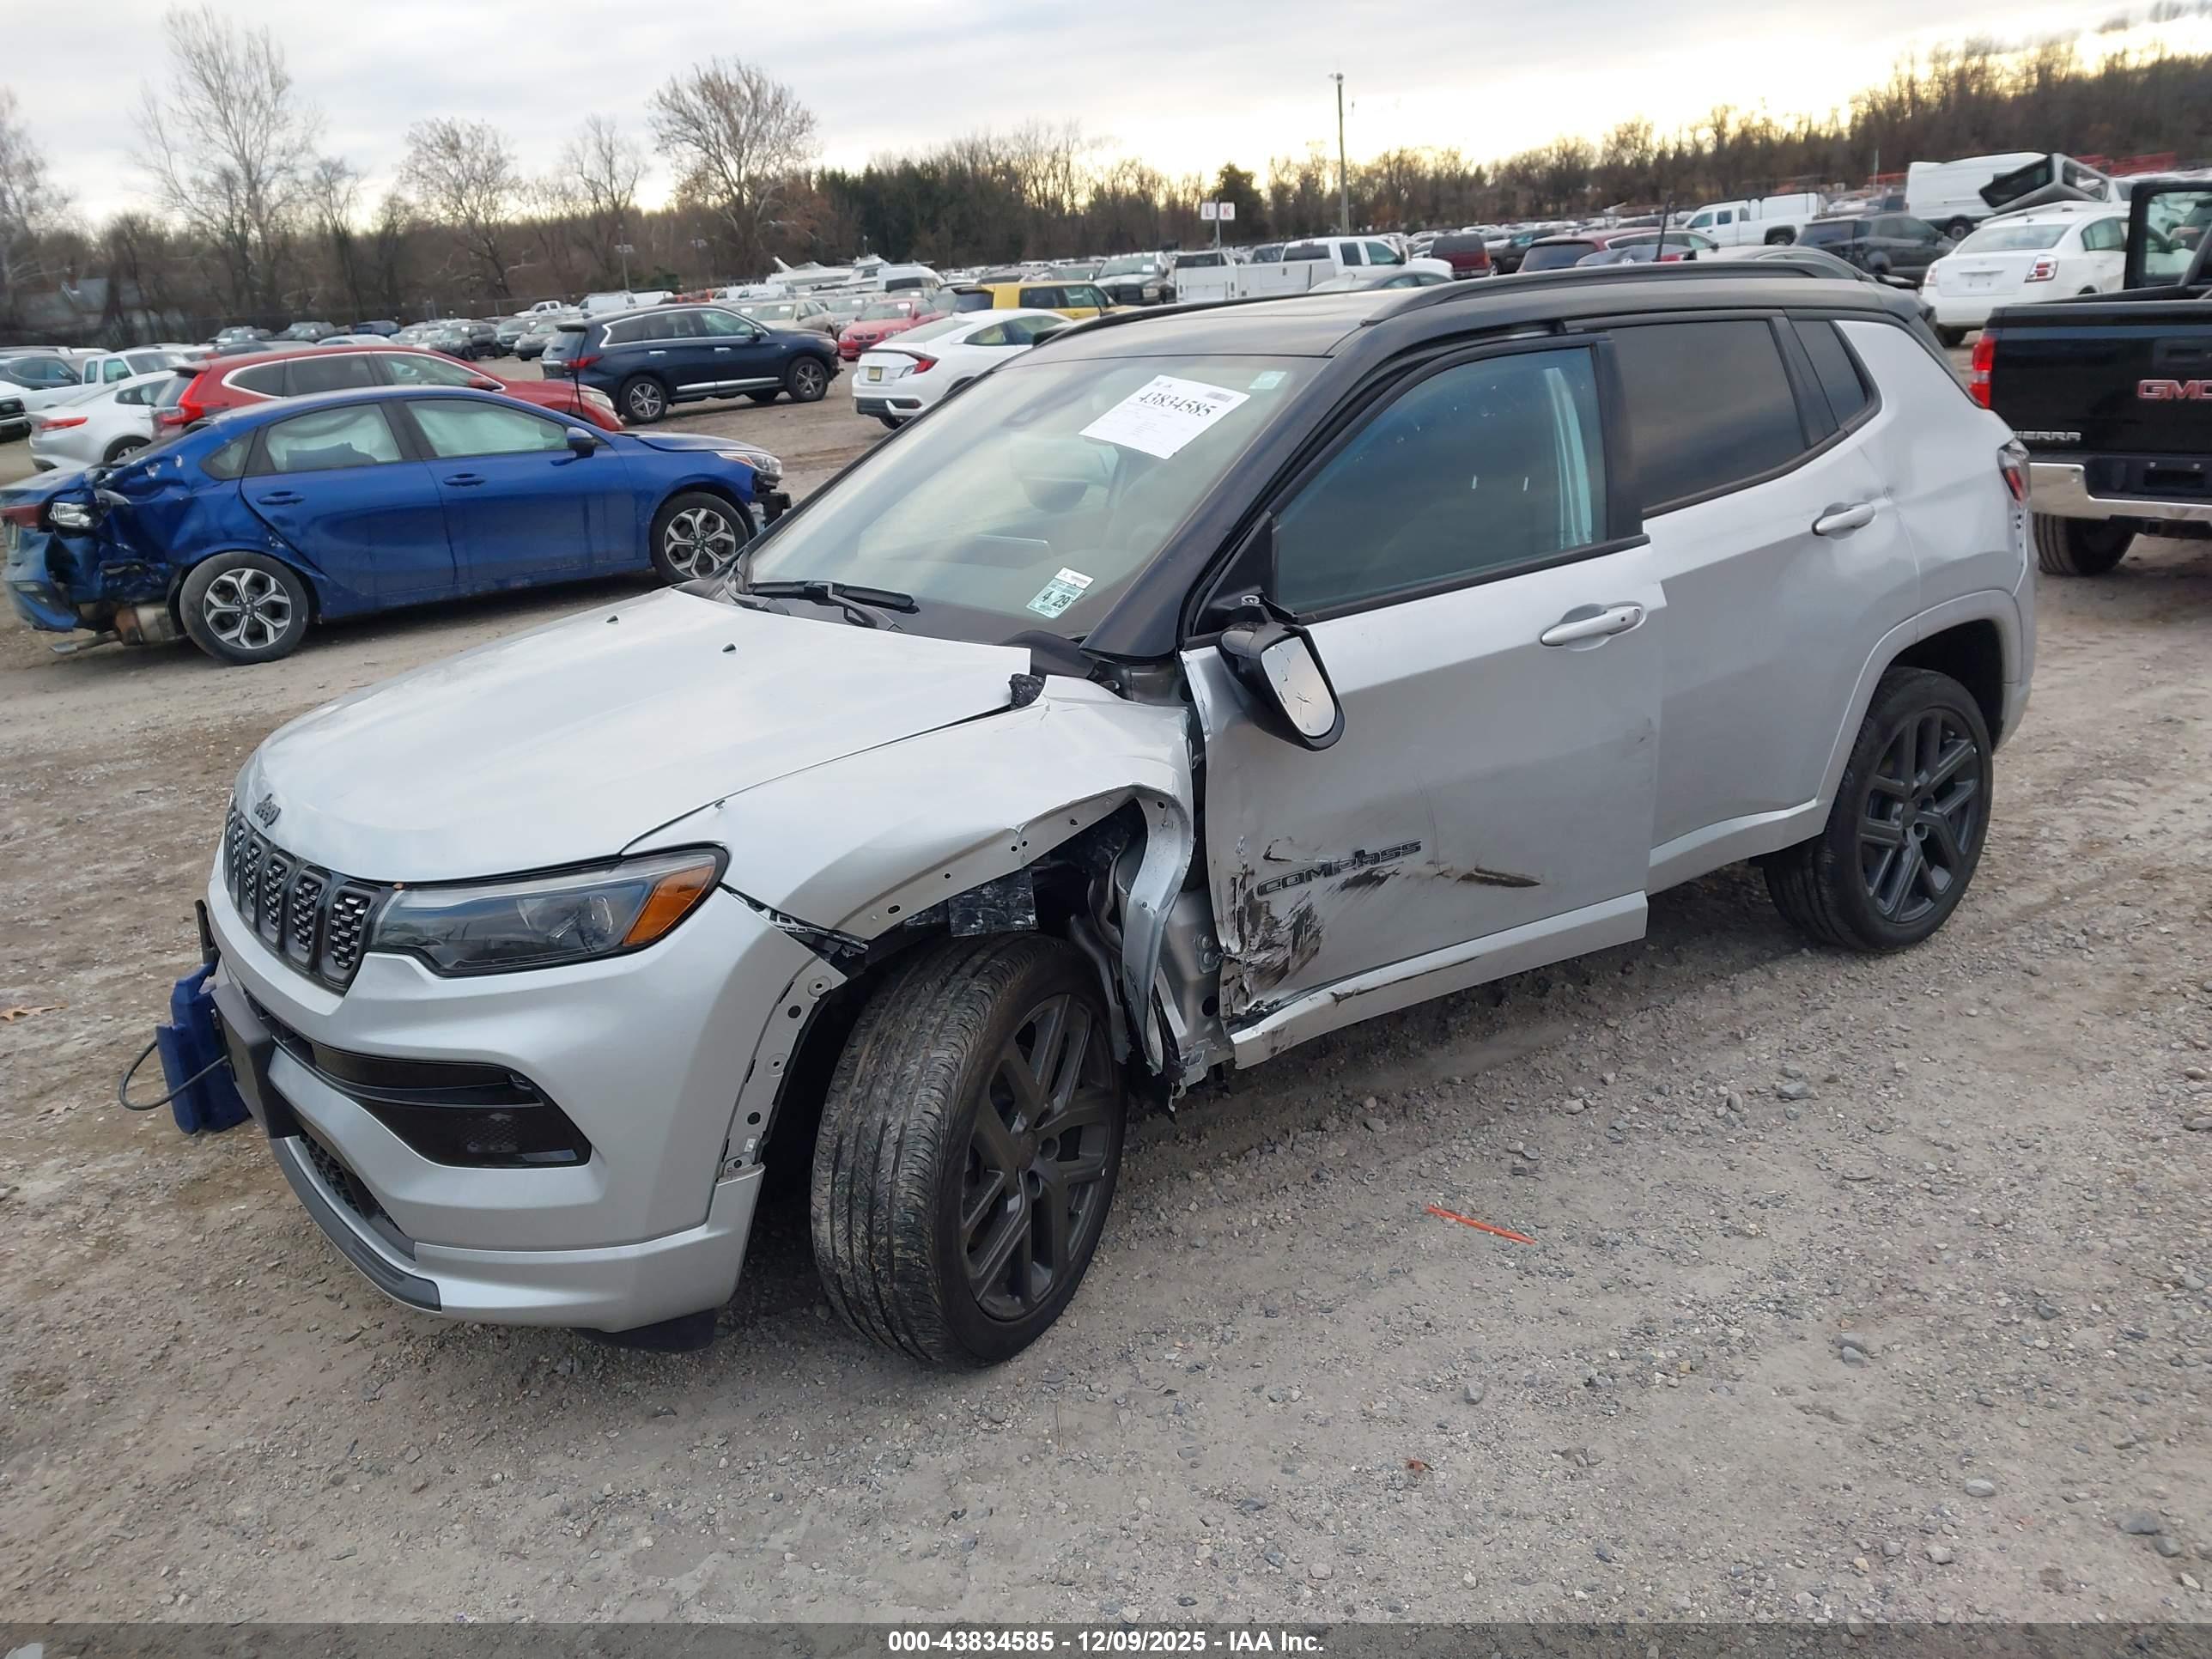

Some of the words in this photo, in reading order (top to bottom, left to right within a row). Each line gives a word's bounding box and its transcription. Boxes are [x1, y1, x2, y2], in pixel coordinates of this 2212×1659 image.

[1222, 205, 1231, 217] K
[1138, 390, 1217, 418] 43834585
[1042, 589, 1055, 603] 4
[1255, 838, 1423, 897] COMPASS
